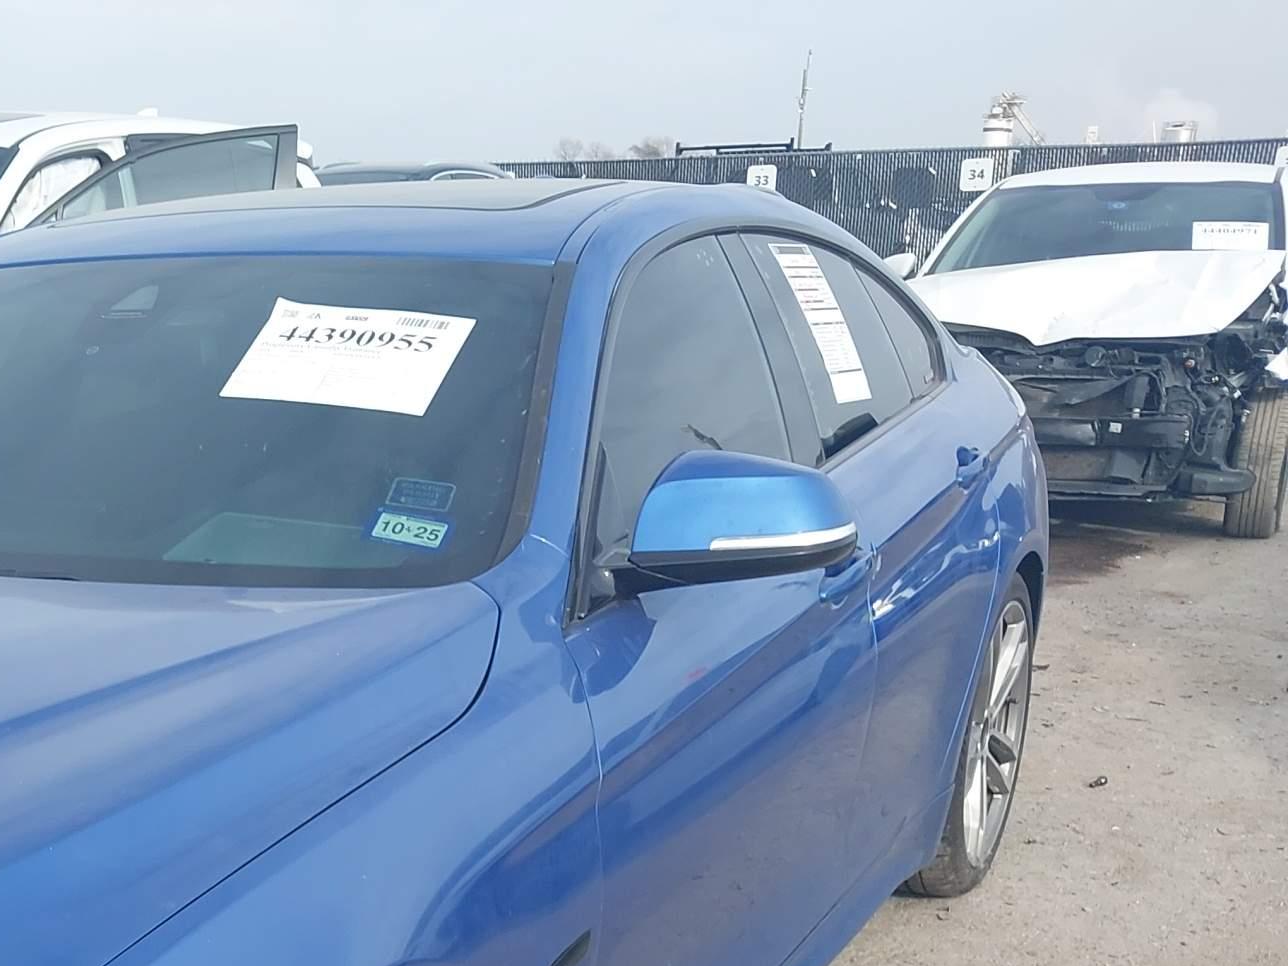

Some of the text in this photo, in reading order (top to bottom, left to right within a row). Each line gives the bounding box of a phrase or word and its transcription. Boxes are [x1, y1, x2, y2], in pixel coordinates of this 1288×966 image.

[754, 175, 769, 186] 33
[967, 168, 985, 181] 34
[279, 325, 438, 353] 44390955
[381, 520, 442, 541] 10 25
